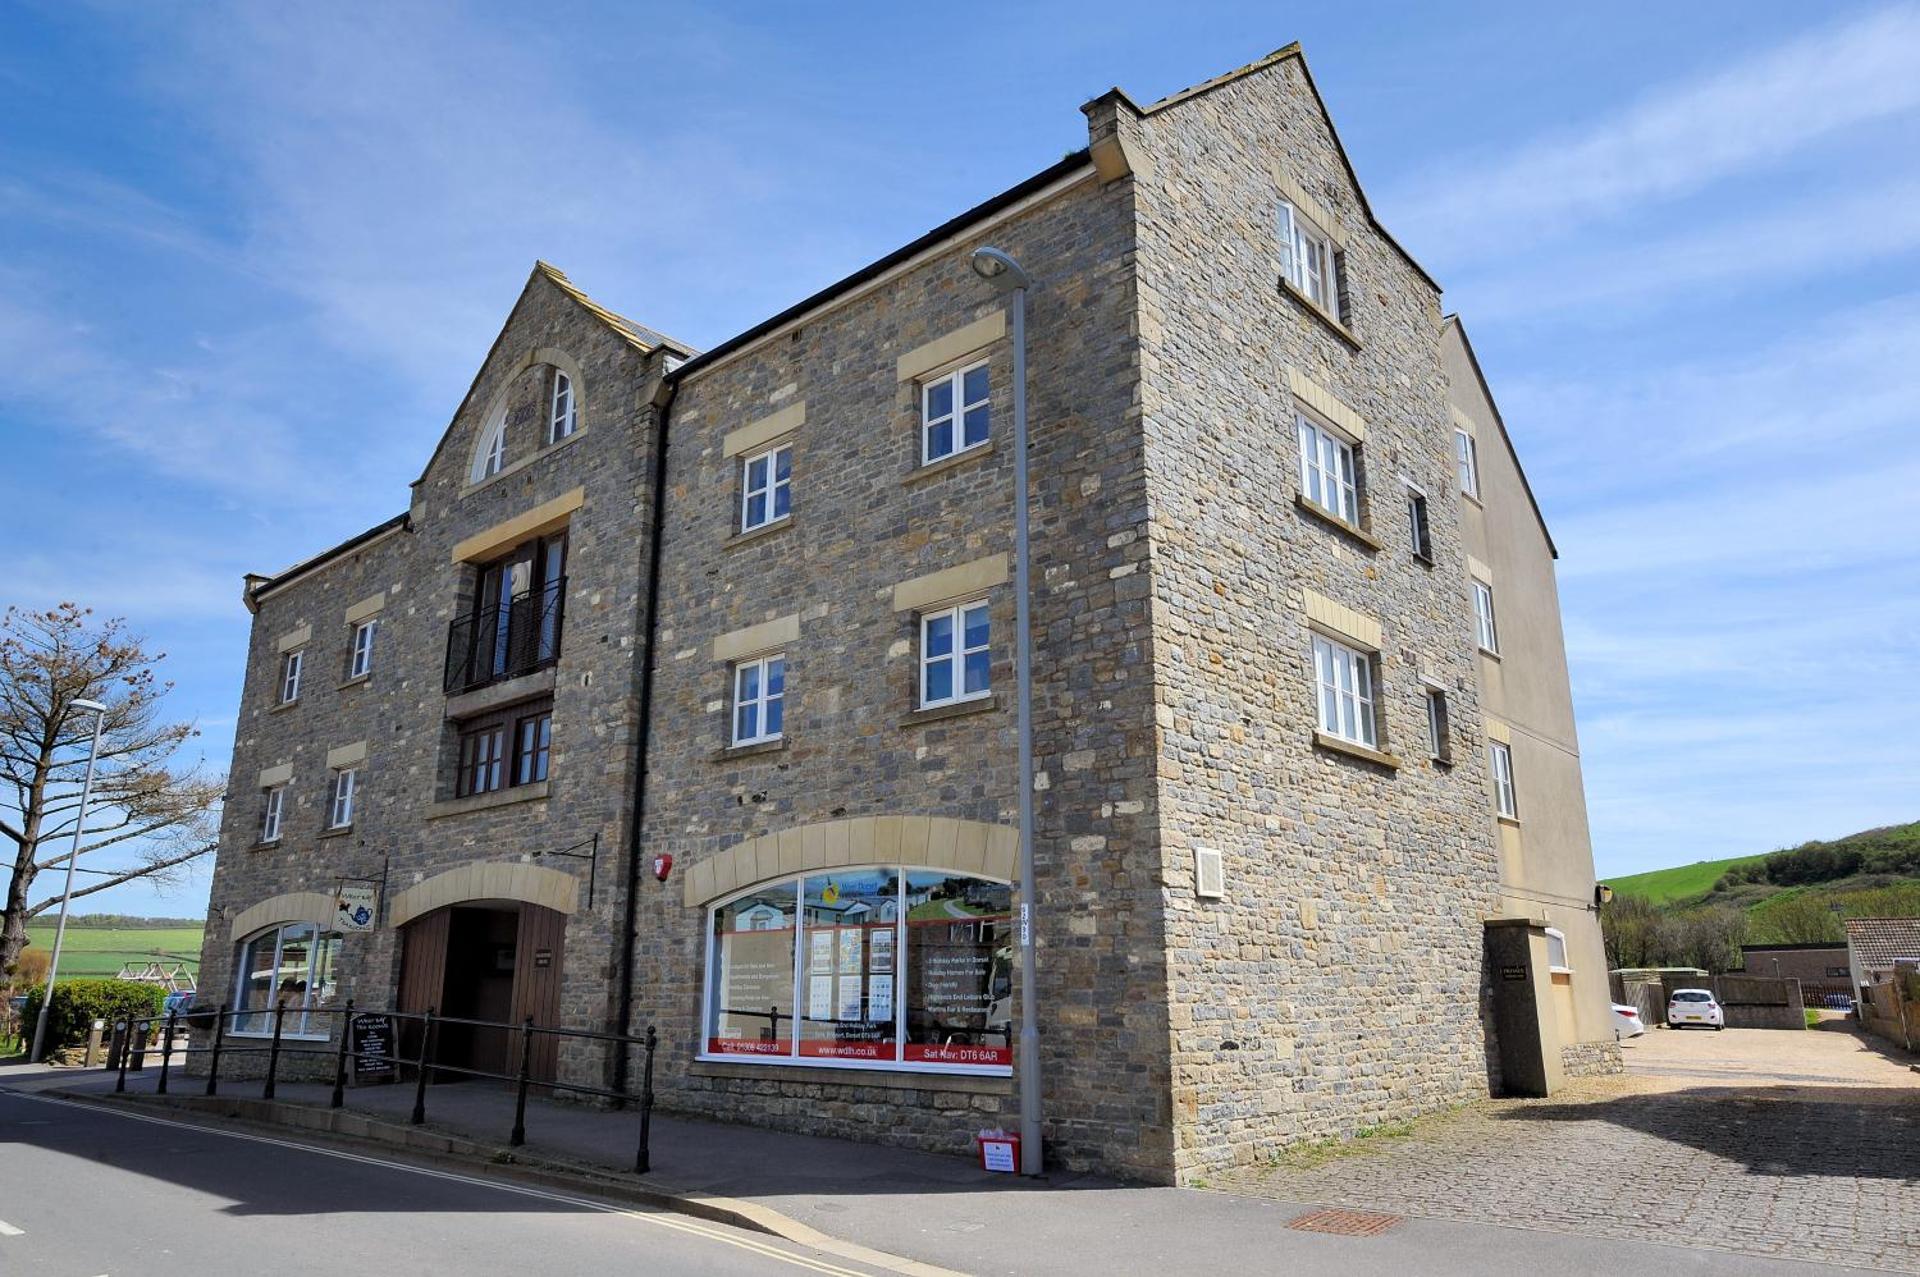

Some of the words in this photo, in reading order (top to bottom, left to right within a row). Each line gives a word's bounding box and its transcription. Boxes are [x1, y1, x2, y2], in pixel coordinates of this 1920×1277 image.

[923, 1048, 938, 1059] Sat
[939, 1049, 959, 1060] Nav:
[960, 1049, 978, 1060] DT6
[978, 1050, 998, 1061] 6AR
